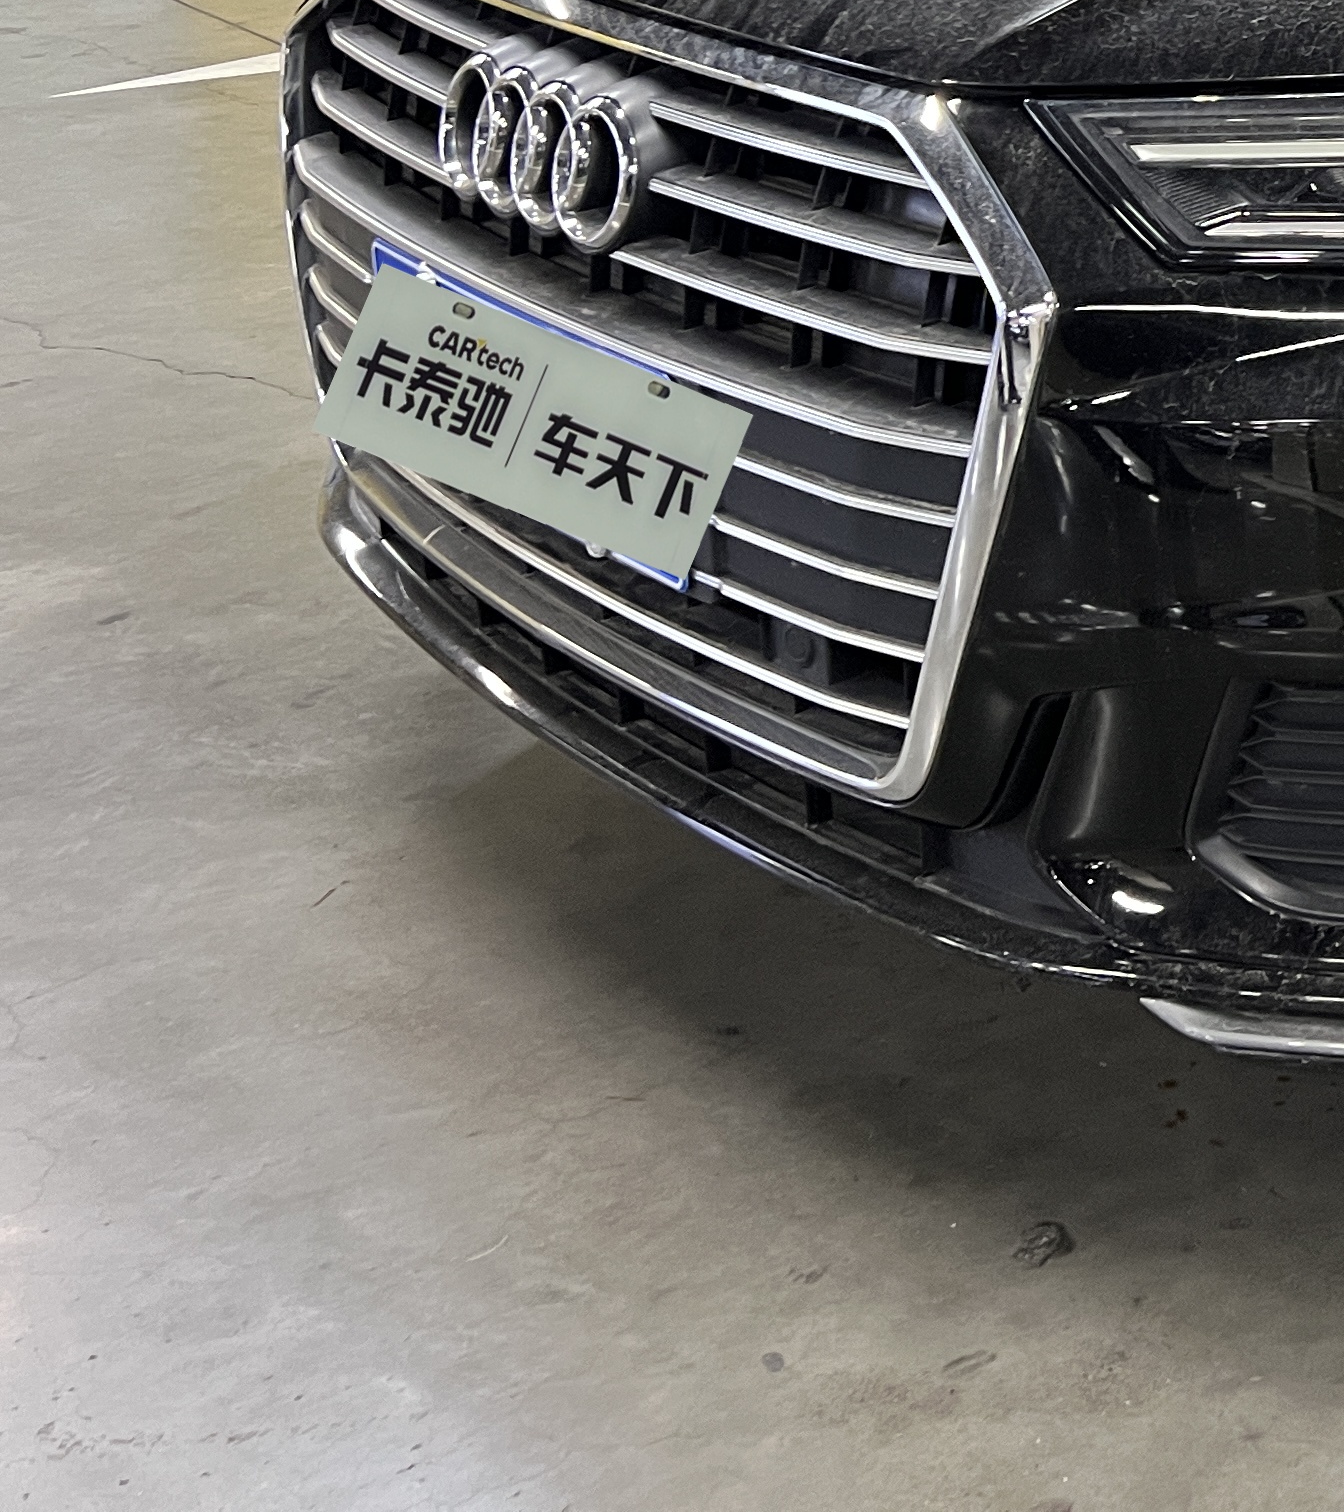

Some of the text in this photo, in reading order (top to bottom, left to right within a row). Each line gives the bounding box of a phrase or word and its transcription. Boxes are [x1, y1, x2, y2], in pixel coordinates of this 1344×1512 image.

[427, 324, 526, 381] CARtech
[356, 338, 709, 520] 卡泰驰 车天下
